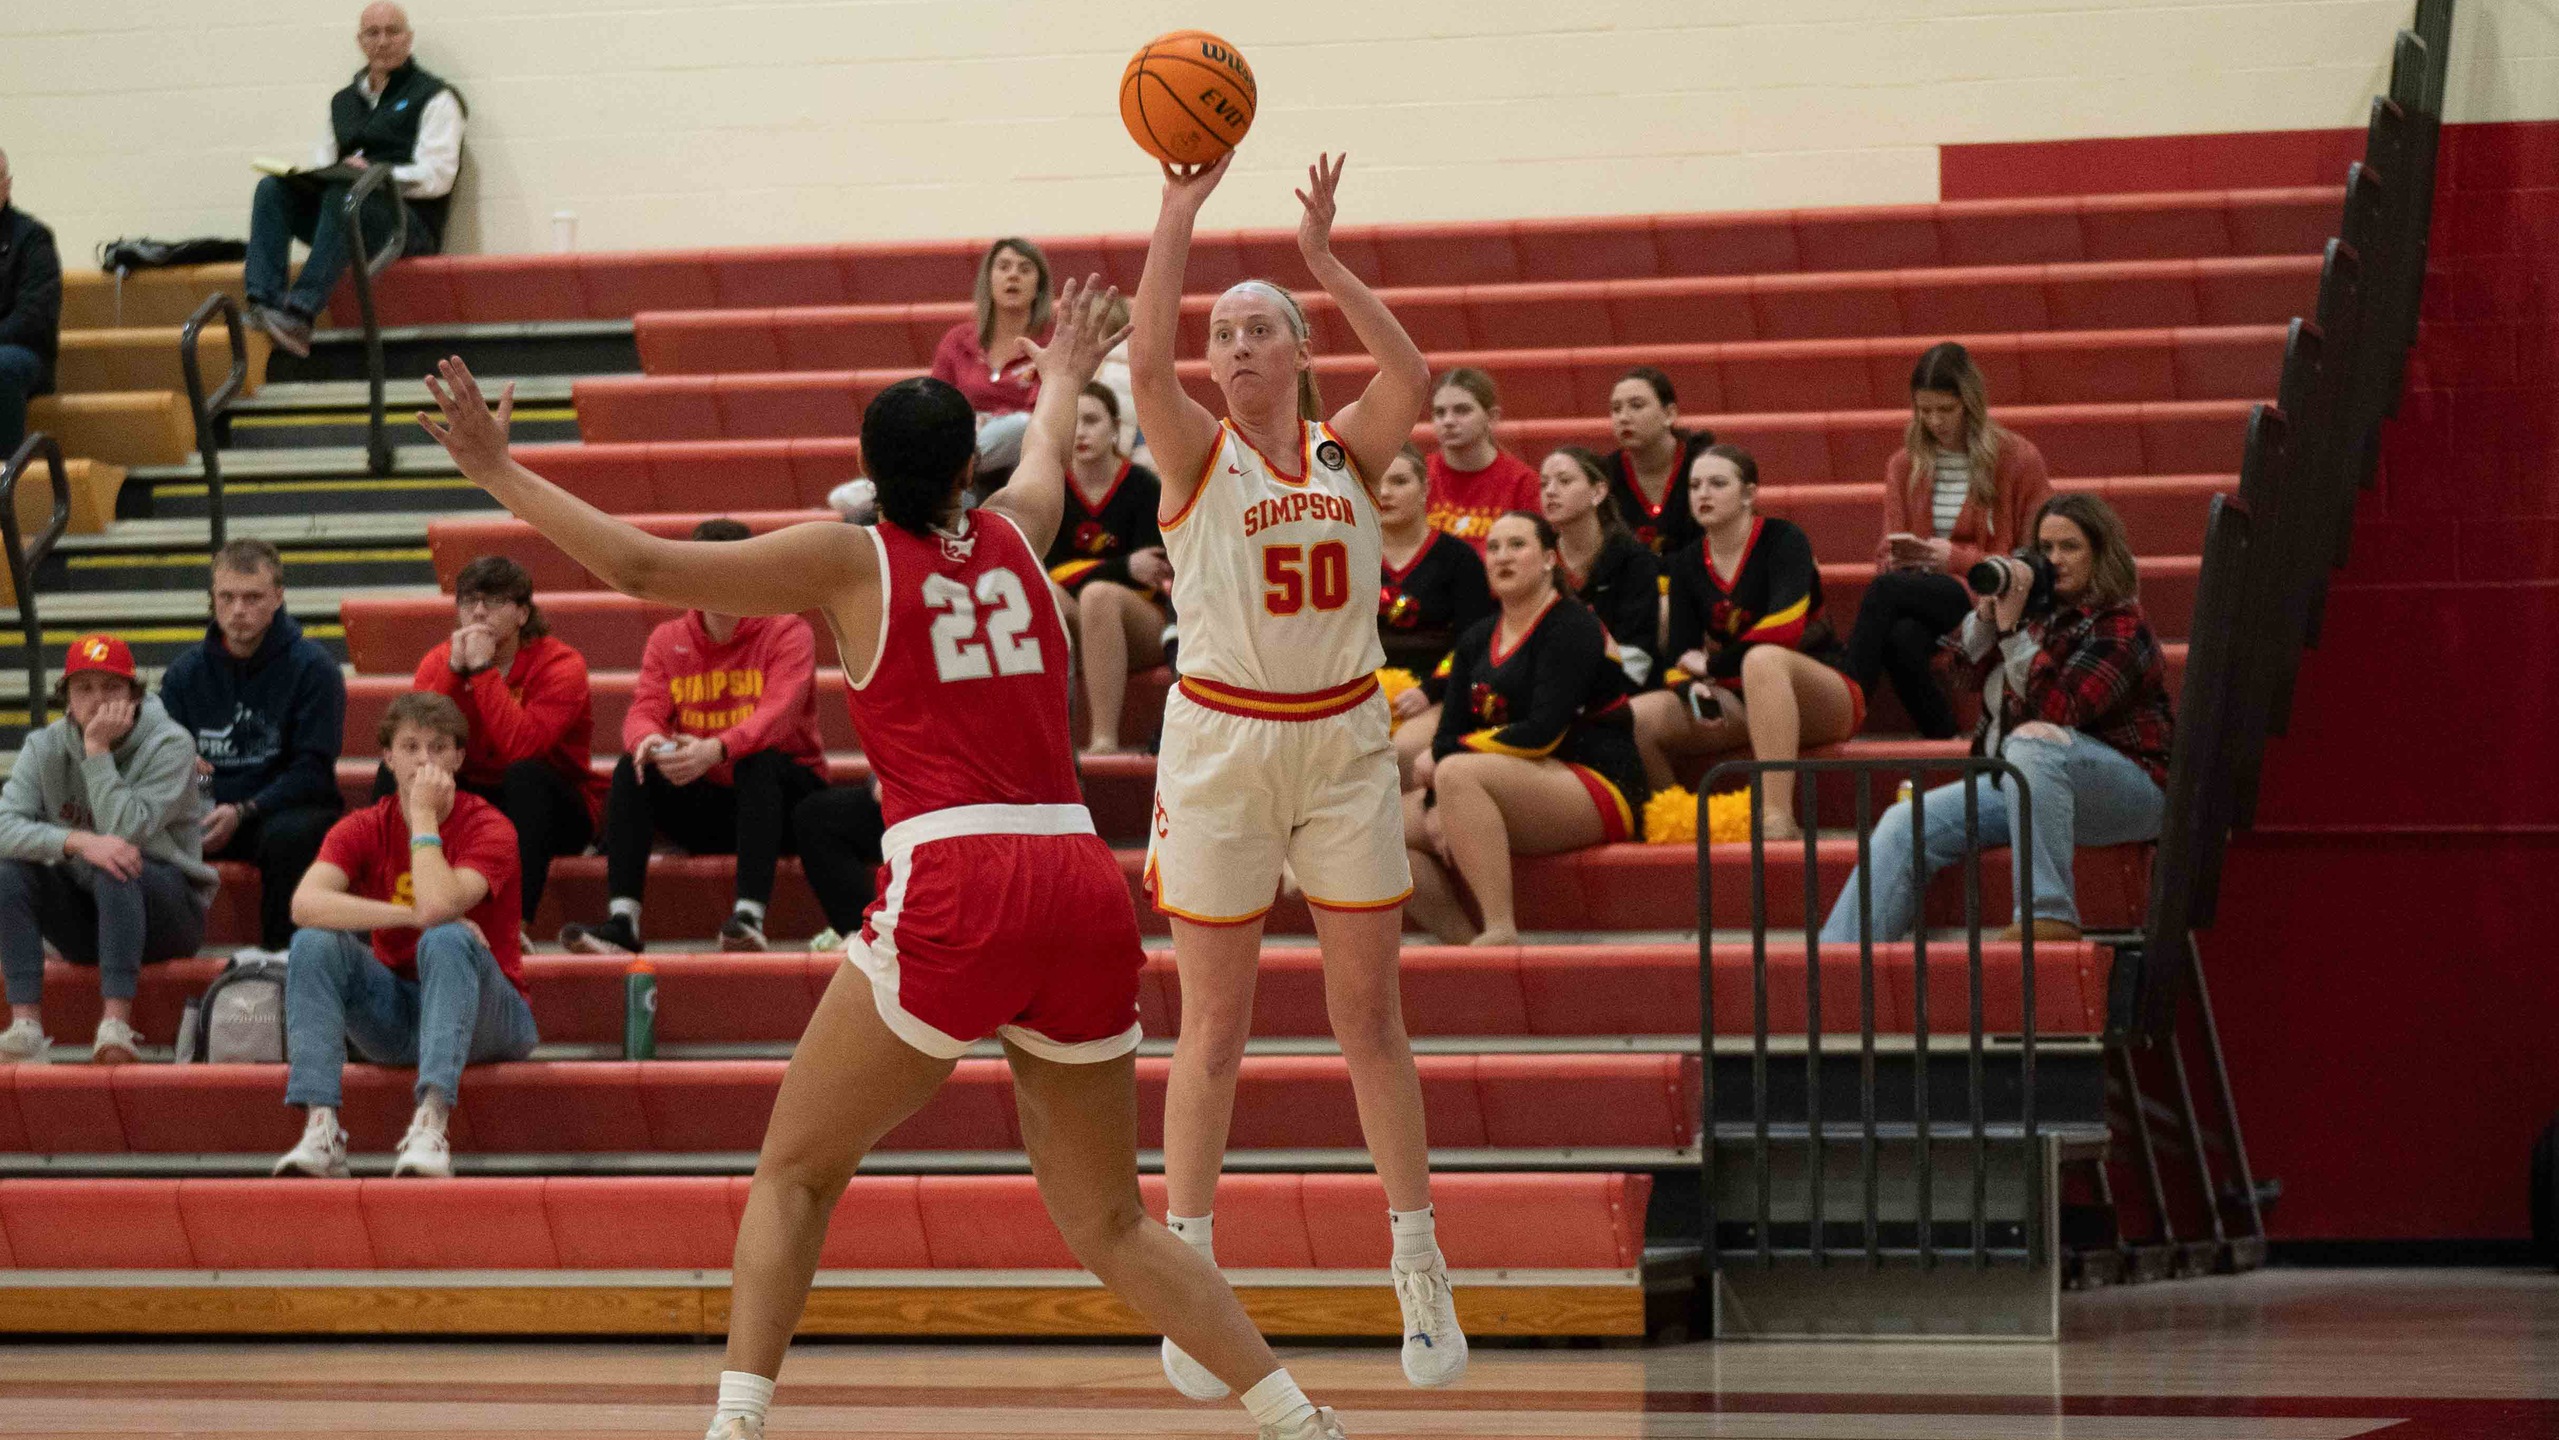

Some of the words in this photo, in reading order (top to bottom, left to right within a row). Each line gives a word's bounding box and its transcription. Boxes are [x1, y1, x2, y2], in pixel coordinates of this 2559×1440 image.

[1244, 492, 1357, 538] SIMPSON
[1262, 538, 1349, 617] 50
[921, 567, 1045, 683] 22
